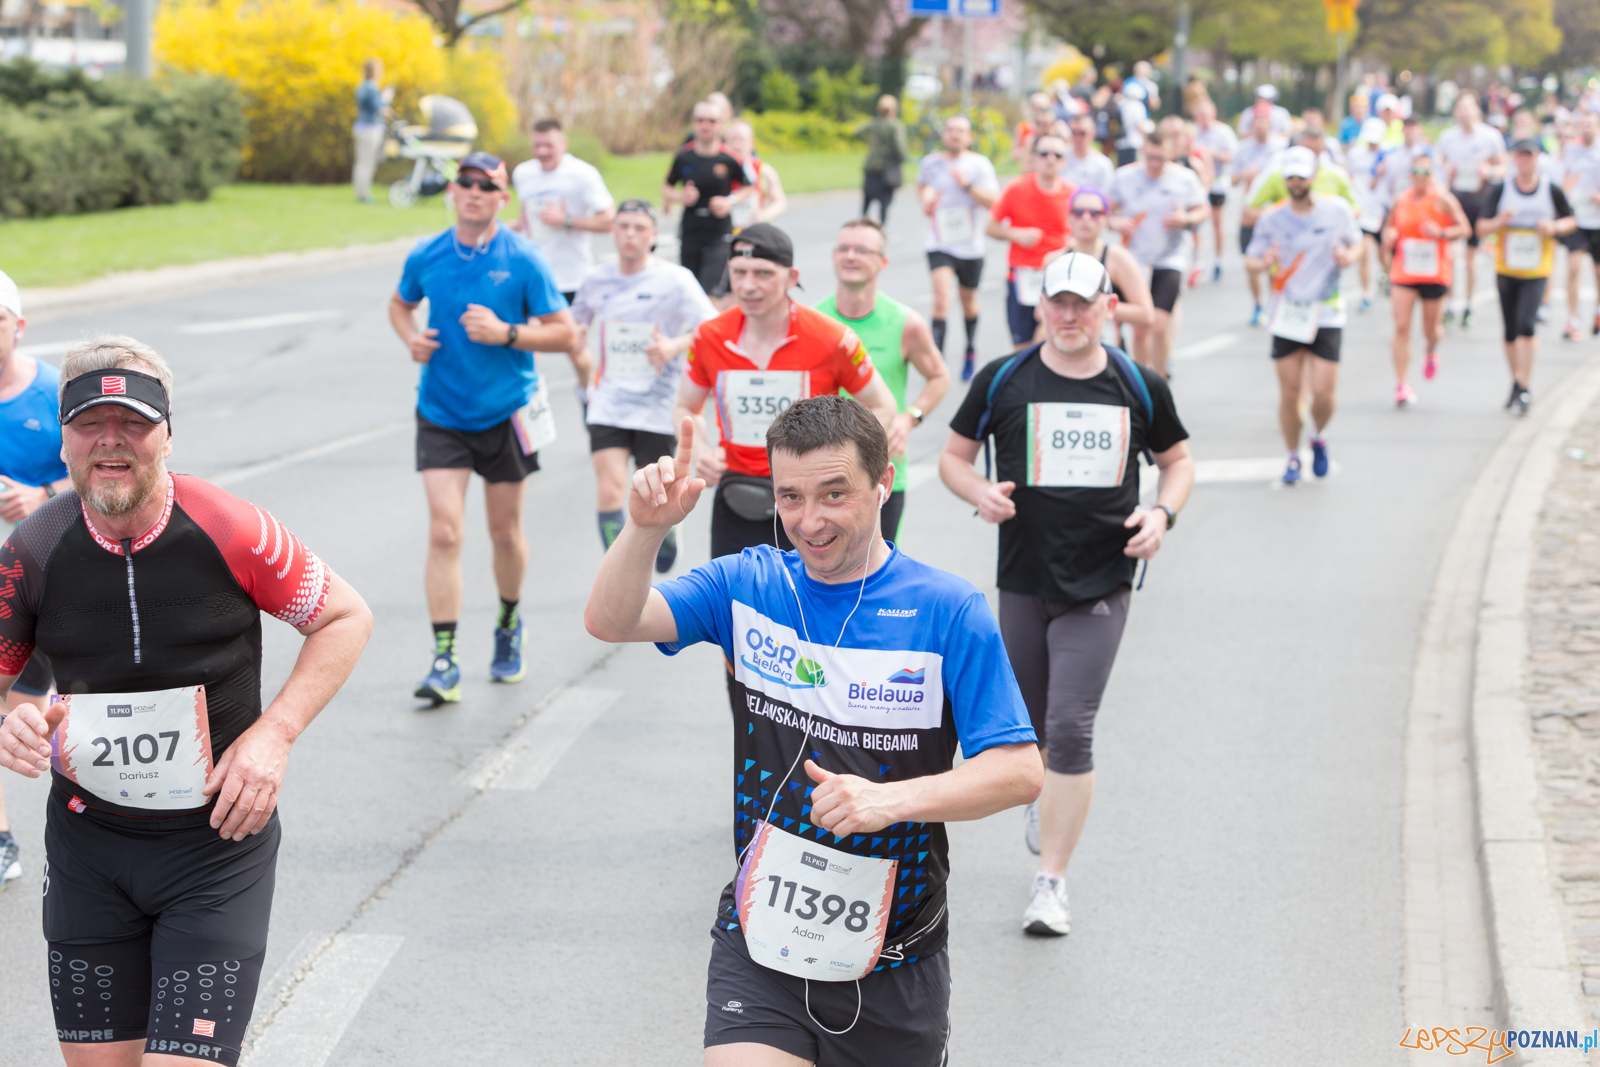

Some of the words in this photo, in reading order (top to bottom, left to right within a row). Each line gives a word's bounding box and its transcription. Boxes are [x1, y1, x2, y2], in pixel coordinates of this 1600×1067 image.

[737, 396, 791, 415] 3350
[1052, 430, 1112, 450] 8988
[848, 682, 924, 703] Bielawa
[91, 730, 180, 767] 2107
[862, 732, 918, 751] BIEGANIA
[119, 771, 160, 781] Dariusz
[768, 875, 871, 933] 11398
[792, 925, 825, 942] Adam
